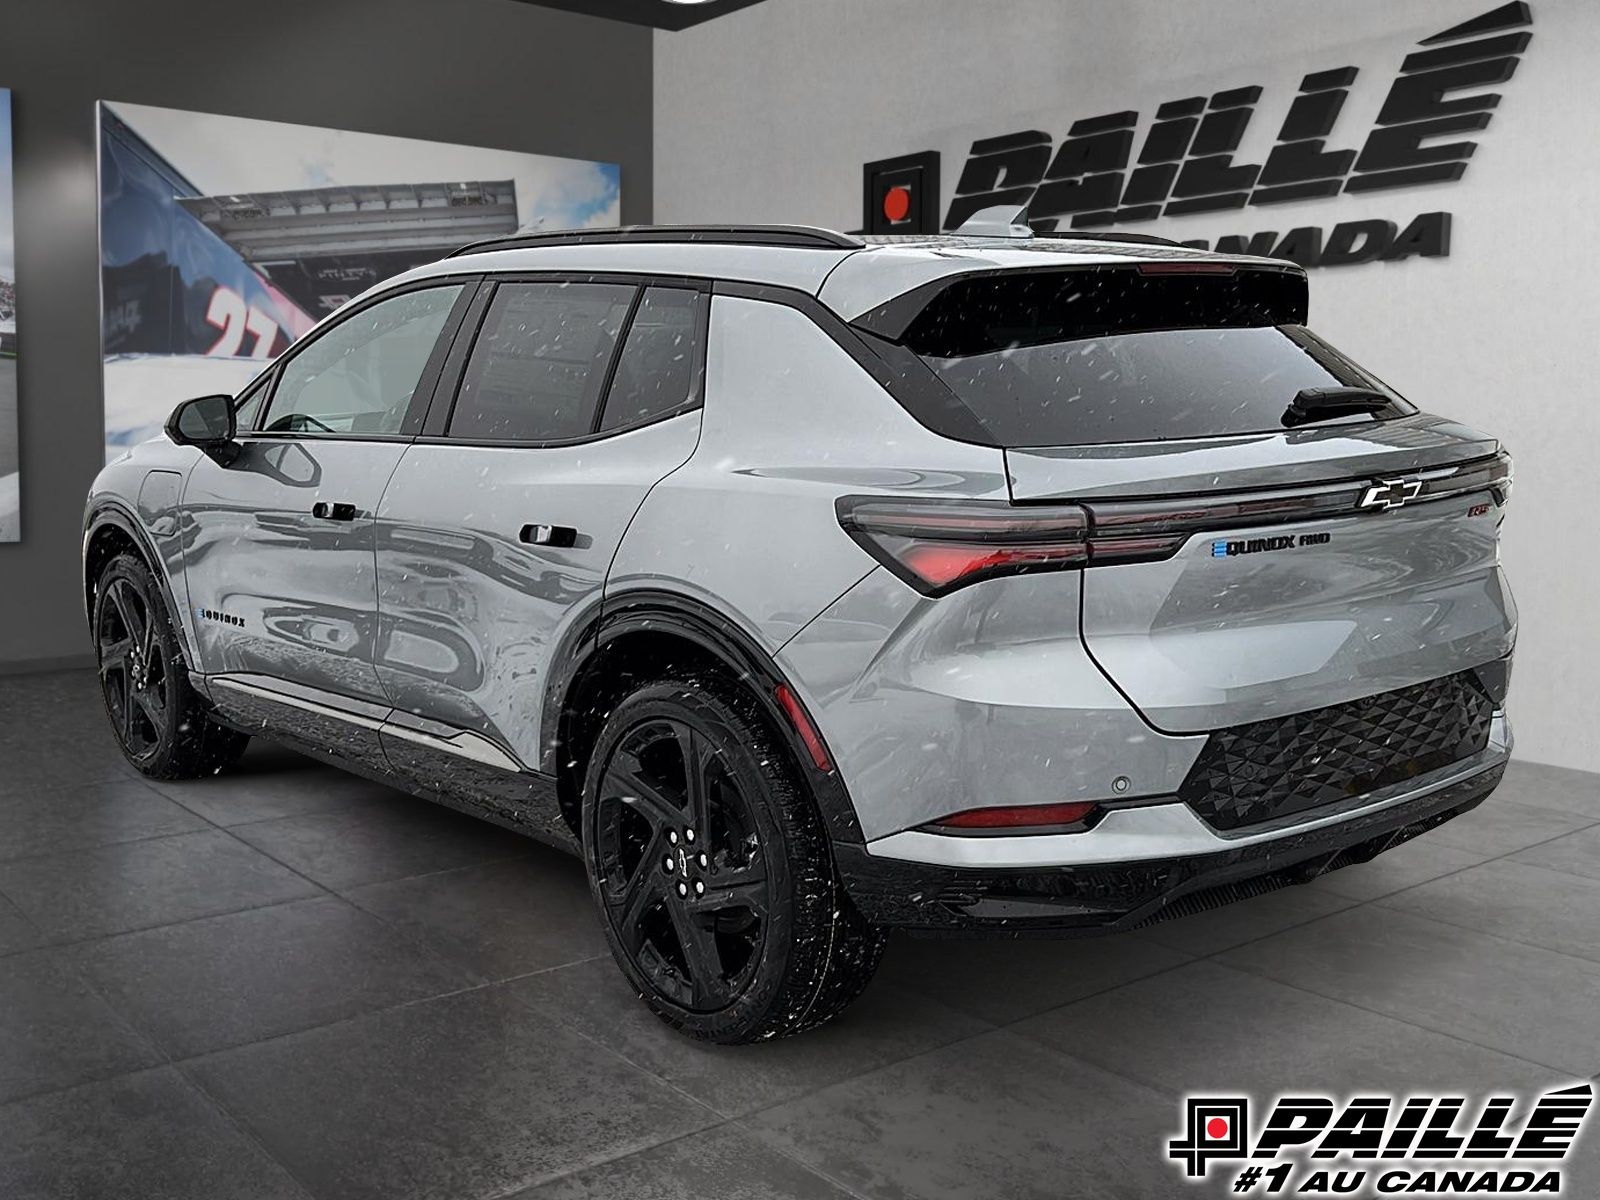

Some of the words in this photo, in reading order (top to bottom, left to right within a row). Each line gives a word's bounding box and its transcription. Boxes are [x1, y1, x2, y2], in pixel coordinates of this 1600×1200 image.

[943, 1, 1533, 232] PAILLÉ
[206, 285, 279, 359] 27
[1211, 535, 1296, 558] EQUINOX
